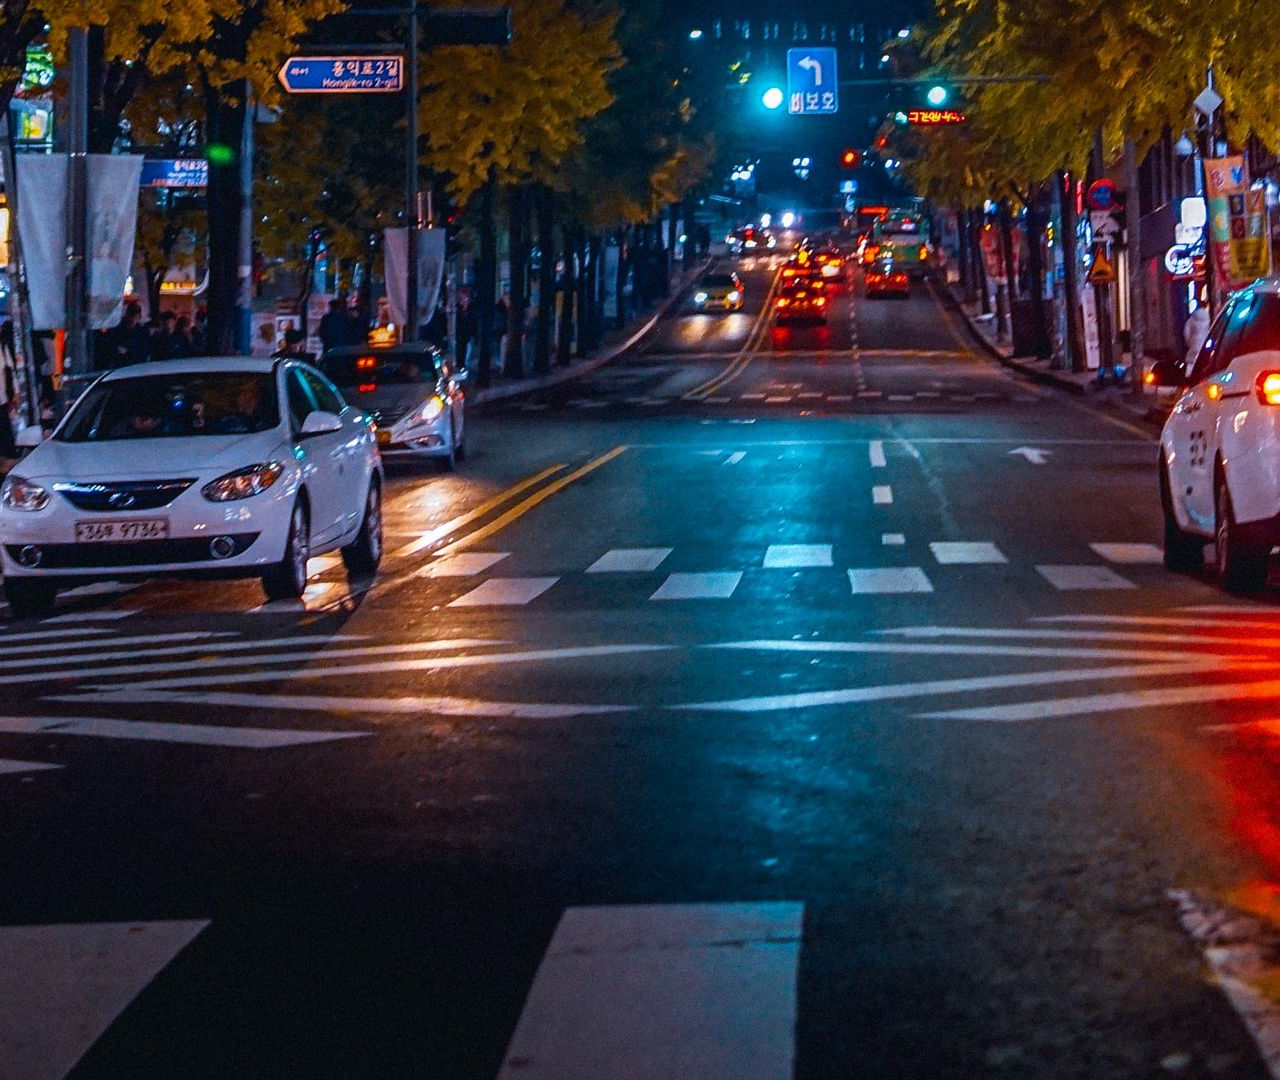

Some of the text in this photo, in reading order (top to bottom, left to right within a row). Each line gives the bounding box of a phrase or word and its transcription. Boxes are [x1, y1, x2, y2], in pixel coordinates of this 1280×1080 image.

[331, 60, 398, 77] 홍익로2길
[322, 78, 372, 89] Hongik-ro
[791, 91, 834, 113] 비보호
[120, 522, 158, 538] 9736
